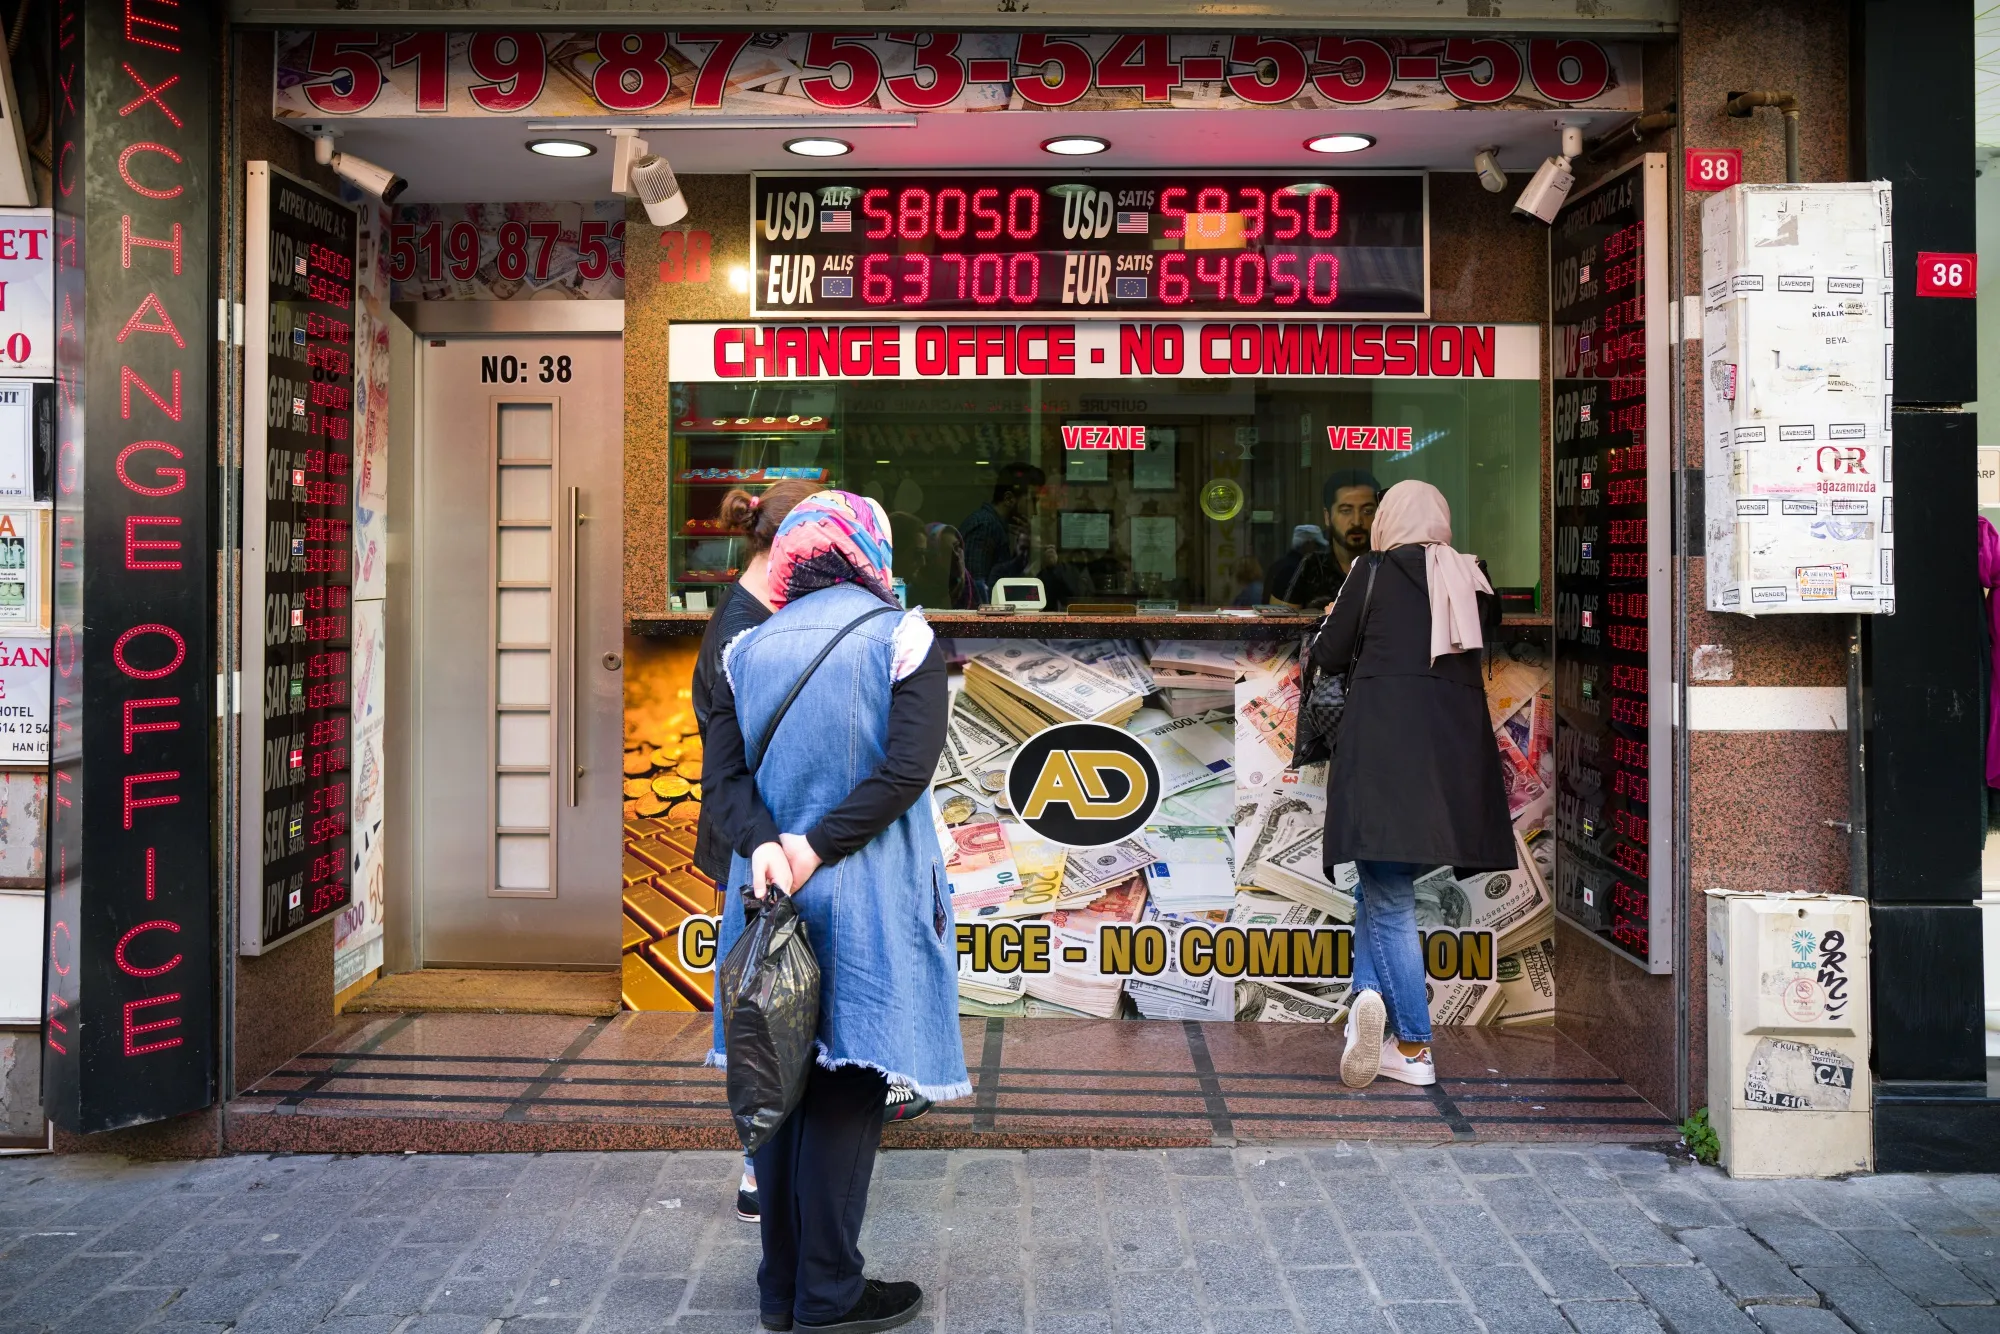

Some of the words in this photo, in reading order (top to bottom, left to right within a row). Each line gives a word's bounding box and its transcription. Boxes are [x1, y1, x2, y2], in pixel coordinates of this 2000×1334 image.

[303, 32, 547, 114] 519
[591, 32, 755, 112] 87
[1700, 158, 1729, 181] 38
[279, 187, 305, 223] AYPEK
[307, 200, 333, 235] DÖVİZ
[764, 191, 815, 241] USD
[821, 190, 852, 207] ALIŞ
[1062, 190, 1114, 240] USD
[1117, 190, 1155, 208] SATIŞ
[1564, 207, 1590, 240] AYPEK
[1590, 188, 1617, 226] DÖVİZ
[270, 229, 293, 288] USD
[390, 221, 481, 281] 519
[497, 221, 561, 281] 87
[658, 230, 712, 283] 38
[1932, 263, 1963, 287] 36
[117, 0, 185, 571] EXCHANGE
[766, 254, 816, 305] EUR
[822, 254, 854, 272] ALIŞ
[1061, 254, 1112, 305] EUR
[1116, 254, 1154, 274] SATIŞ
[1555, 256, 1578, 312] USD
[1780, 280, 1811, 289] LAVENDER
[1830, 282, 1861, 290] LAVENDER
[268, 303, 292, 358] EUR
[1812, 310, 1845, 318] KİRALIK
[481, 355, 527, 383] NO:
[539, 355, 572, 383] 38
[713, 326, 901, 378] CHANGE
[915, 324, 1076, 377] OFFICE
[1119, 323, 1185, 375] NO
[1200, 323, 1496, 378] COMMISSION
[267, 374, 292, 429] GBP
[1556, 390, 1579, 444] GBP
[1061, 425, 1146, 451] VEZNE
[1327, 425, 1413, 452] VEZNE
[1736, 431, 1763, 439] LAVENDER
[1782, 429, 1813, 437] LAVENDER
[1832, 428, 1863, 436] LAVENDER
[266, 447, 291, 501] CHF
[1557, 457, 1579, 508] CHF
[266, 520, 291, 573] AUD
[1557, 526, 1580, 575] AUD
[265, 592, 289, 647] CAD
[1557, 591, 1580, 641] CAD
[1754, 591, 1785, 599] LAVENDER
[264, 664, 287, 719] SAR
[12, 742, 34, 752] HAN
[20, 723, 32, 733] 12
[264, 735, 290, 792] DKK
[1022, 750, 1148, 820] AD
[113, 622, 187, 1057] OFFICE
[264, 806, 287, 866] SEK
[264, 879, 286, 940] JPY
[1101, 926, 1166, 976] NO
[1791, 960, 1817, 971] İGDAŞ
